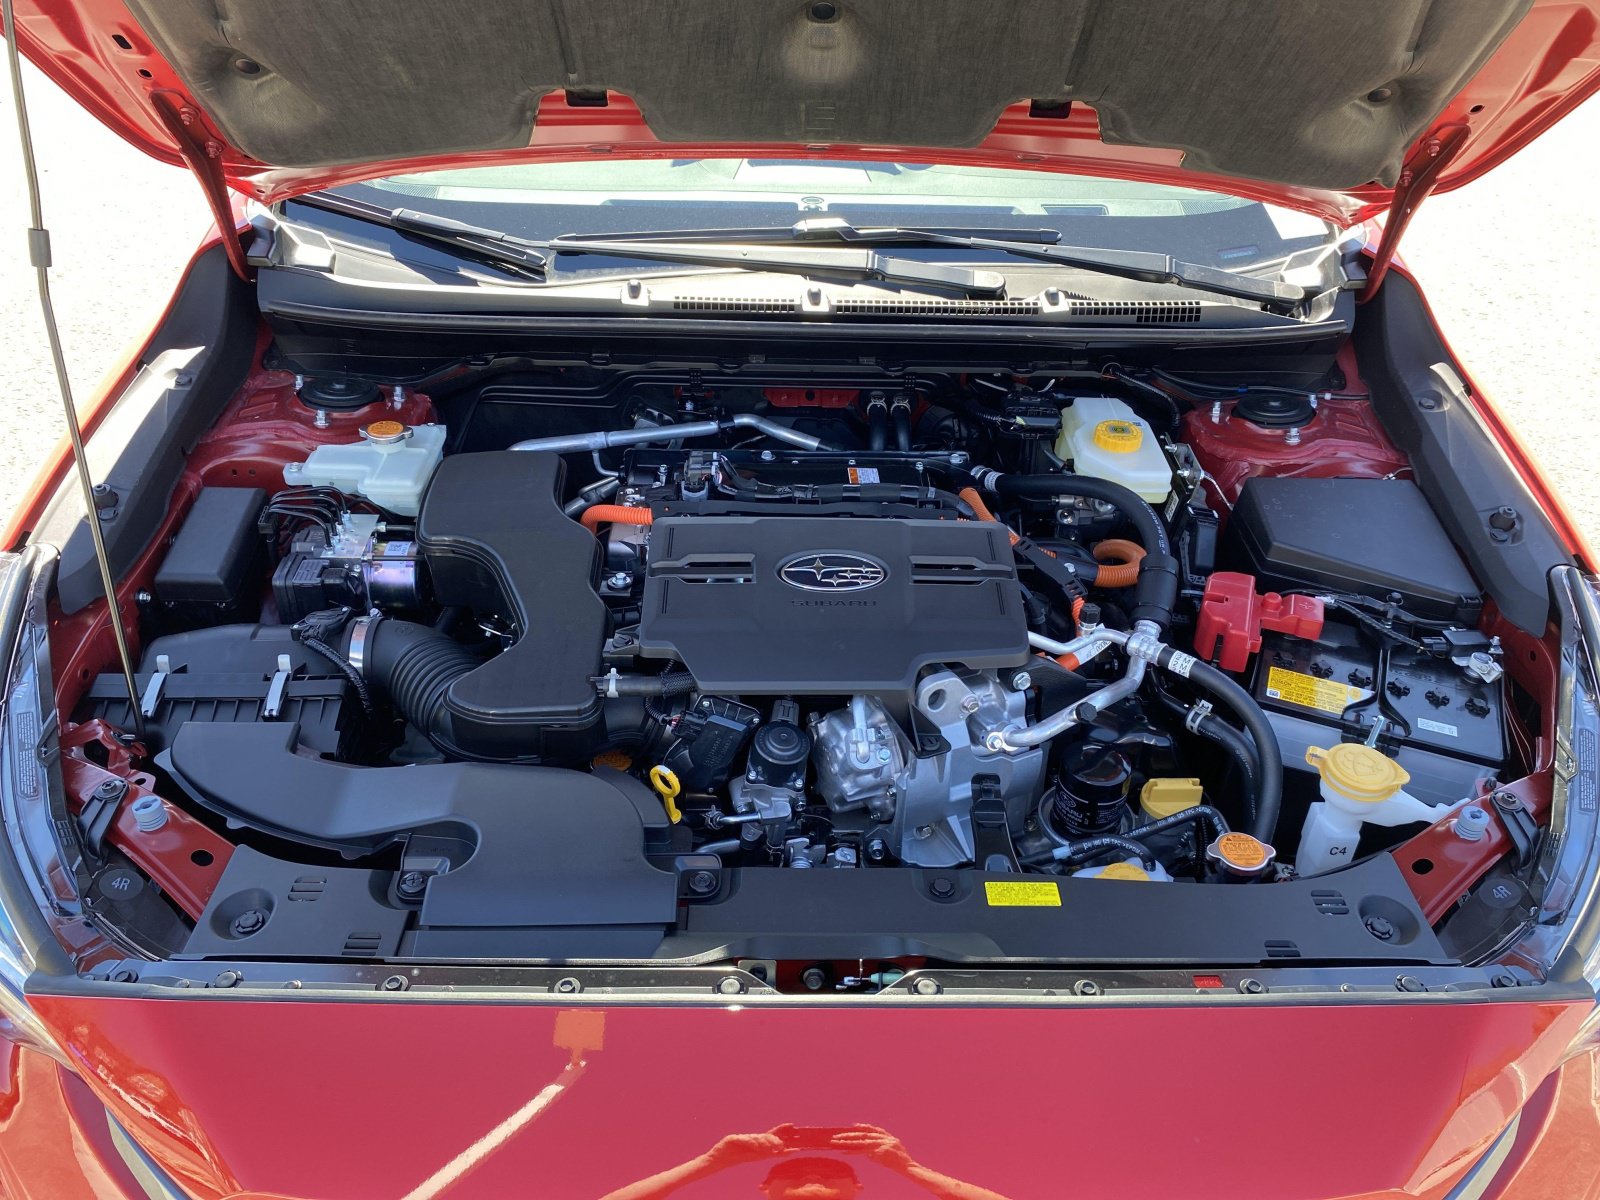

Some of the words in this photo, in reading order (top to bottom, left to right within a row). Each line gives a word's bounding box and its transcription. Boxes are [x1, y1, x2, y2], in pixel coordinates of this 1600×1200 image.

[791, 599, 878, 608] SUBARU
[1329, 846, 1347, 856] C4
[111, 877, 130, 891] 4R
[1492, 885, 1511, 899] 4R
